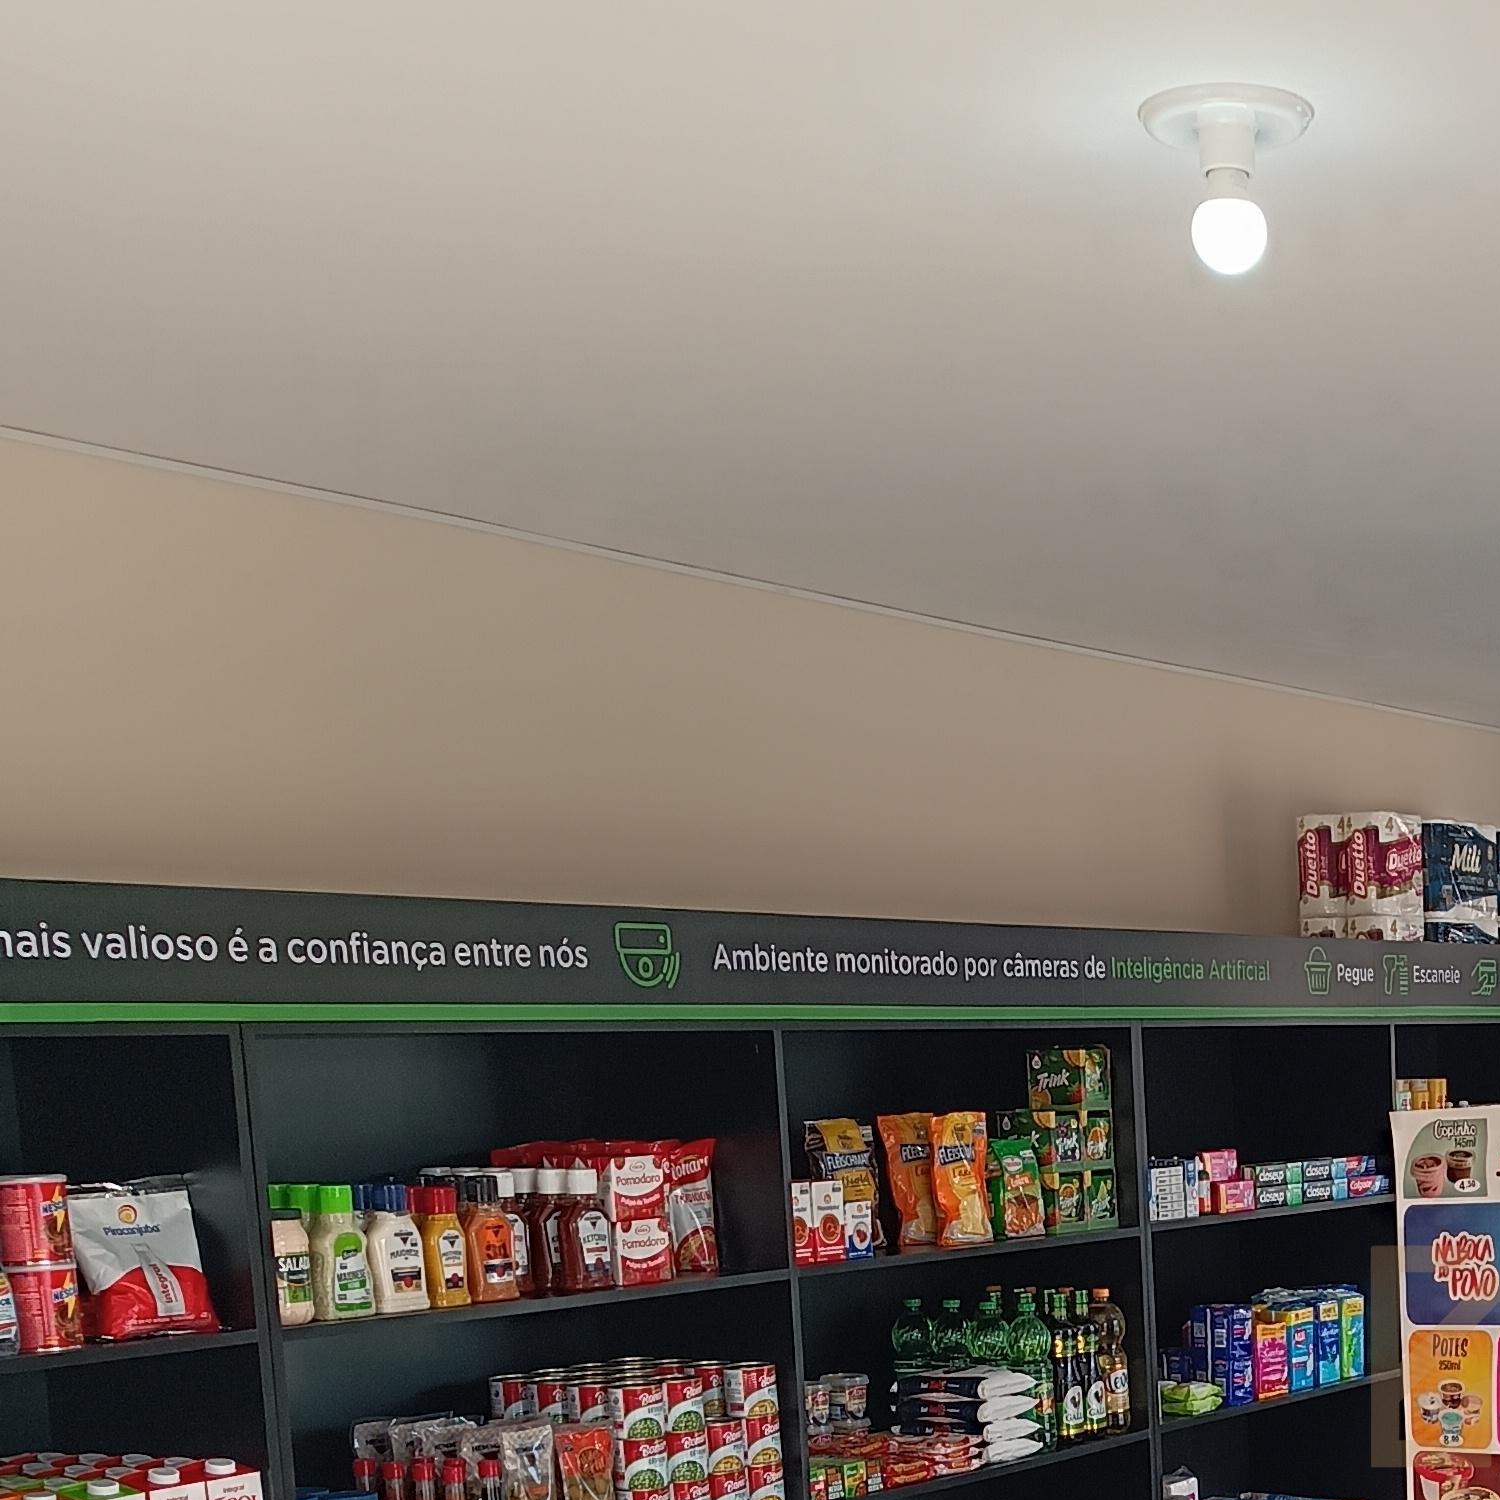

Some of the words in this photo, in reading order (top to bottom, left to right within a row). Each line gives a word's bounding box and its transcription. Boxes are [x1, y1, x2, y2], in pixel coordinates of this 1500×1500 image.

[1306, 830, 1320, 896] Duetto
[1353, 831, 1366, 896] Duetto
[1452, 844, 1481, 874] Mili
[82, 925, 218, 963] valioso
[228, 926, 248, 963] é
[258, 938, 277, 964] a
[287, 931, 446, 971] confiança
[455, 939, 531, 968] entre
[539, 938, 588, 969] nós
[713, 943, 828, 974] Ambiente
[835, 946, 957, 976] monitorado
[964, 955, 997, 982] por
[1003, 952, 1078, 980] câmeras
[1085, 954, 1106, 979] de
[1111, 956, 1203, 984] Inteligência
[1209, 958, 1270, 982] Artificial
[1337, 963, 1374, 986] Pegue
[1413, 965, 1460, 985] Escaneie
[1037, 1068, 1070, 1092] Trink
[616, 1173, 661, 1187] Pomodoro
[103, 1224, 160, 1237] Piracanjuba
[622, 1236, 666, 1250] Pomodoro
[1434, 1234, 1455, 1263] NA
[1457, 1235, 1491, 1262] BOCA
[1451, 1266, 1496, 1297] POVO
